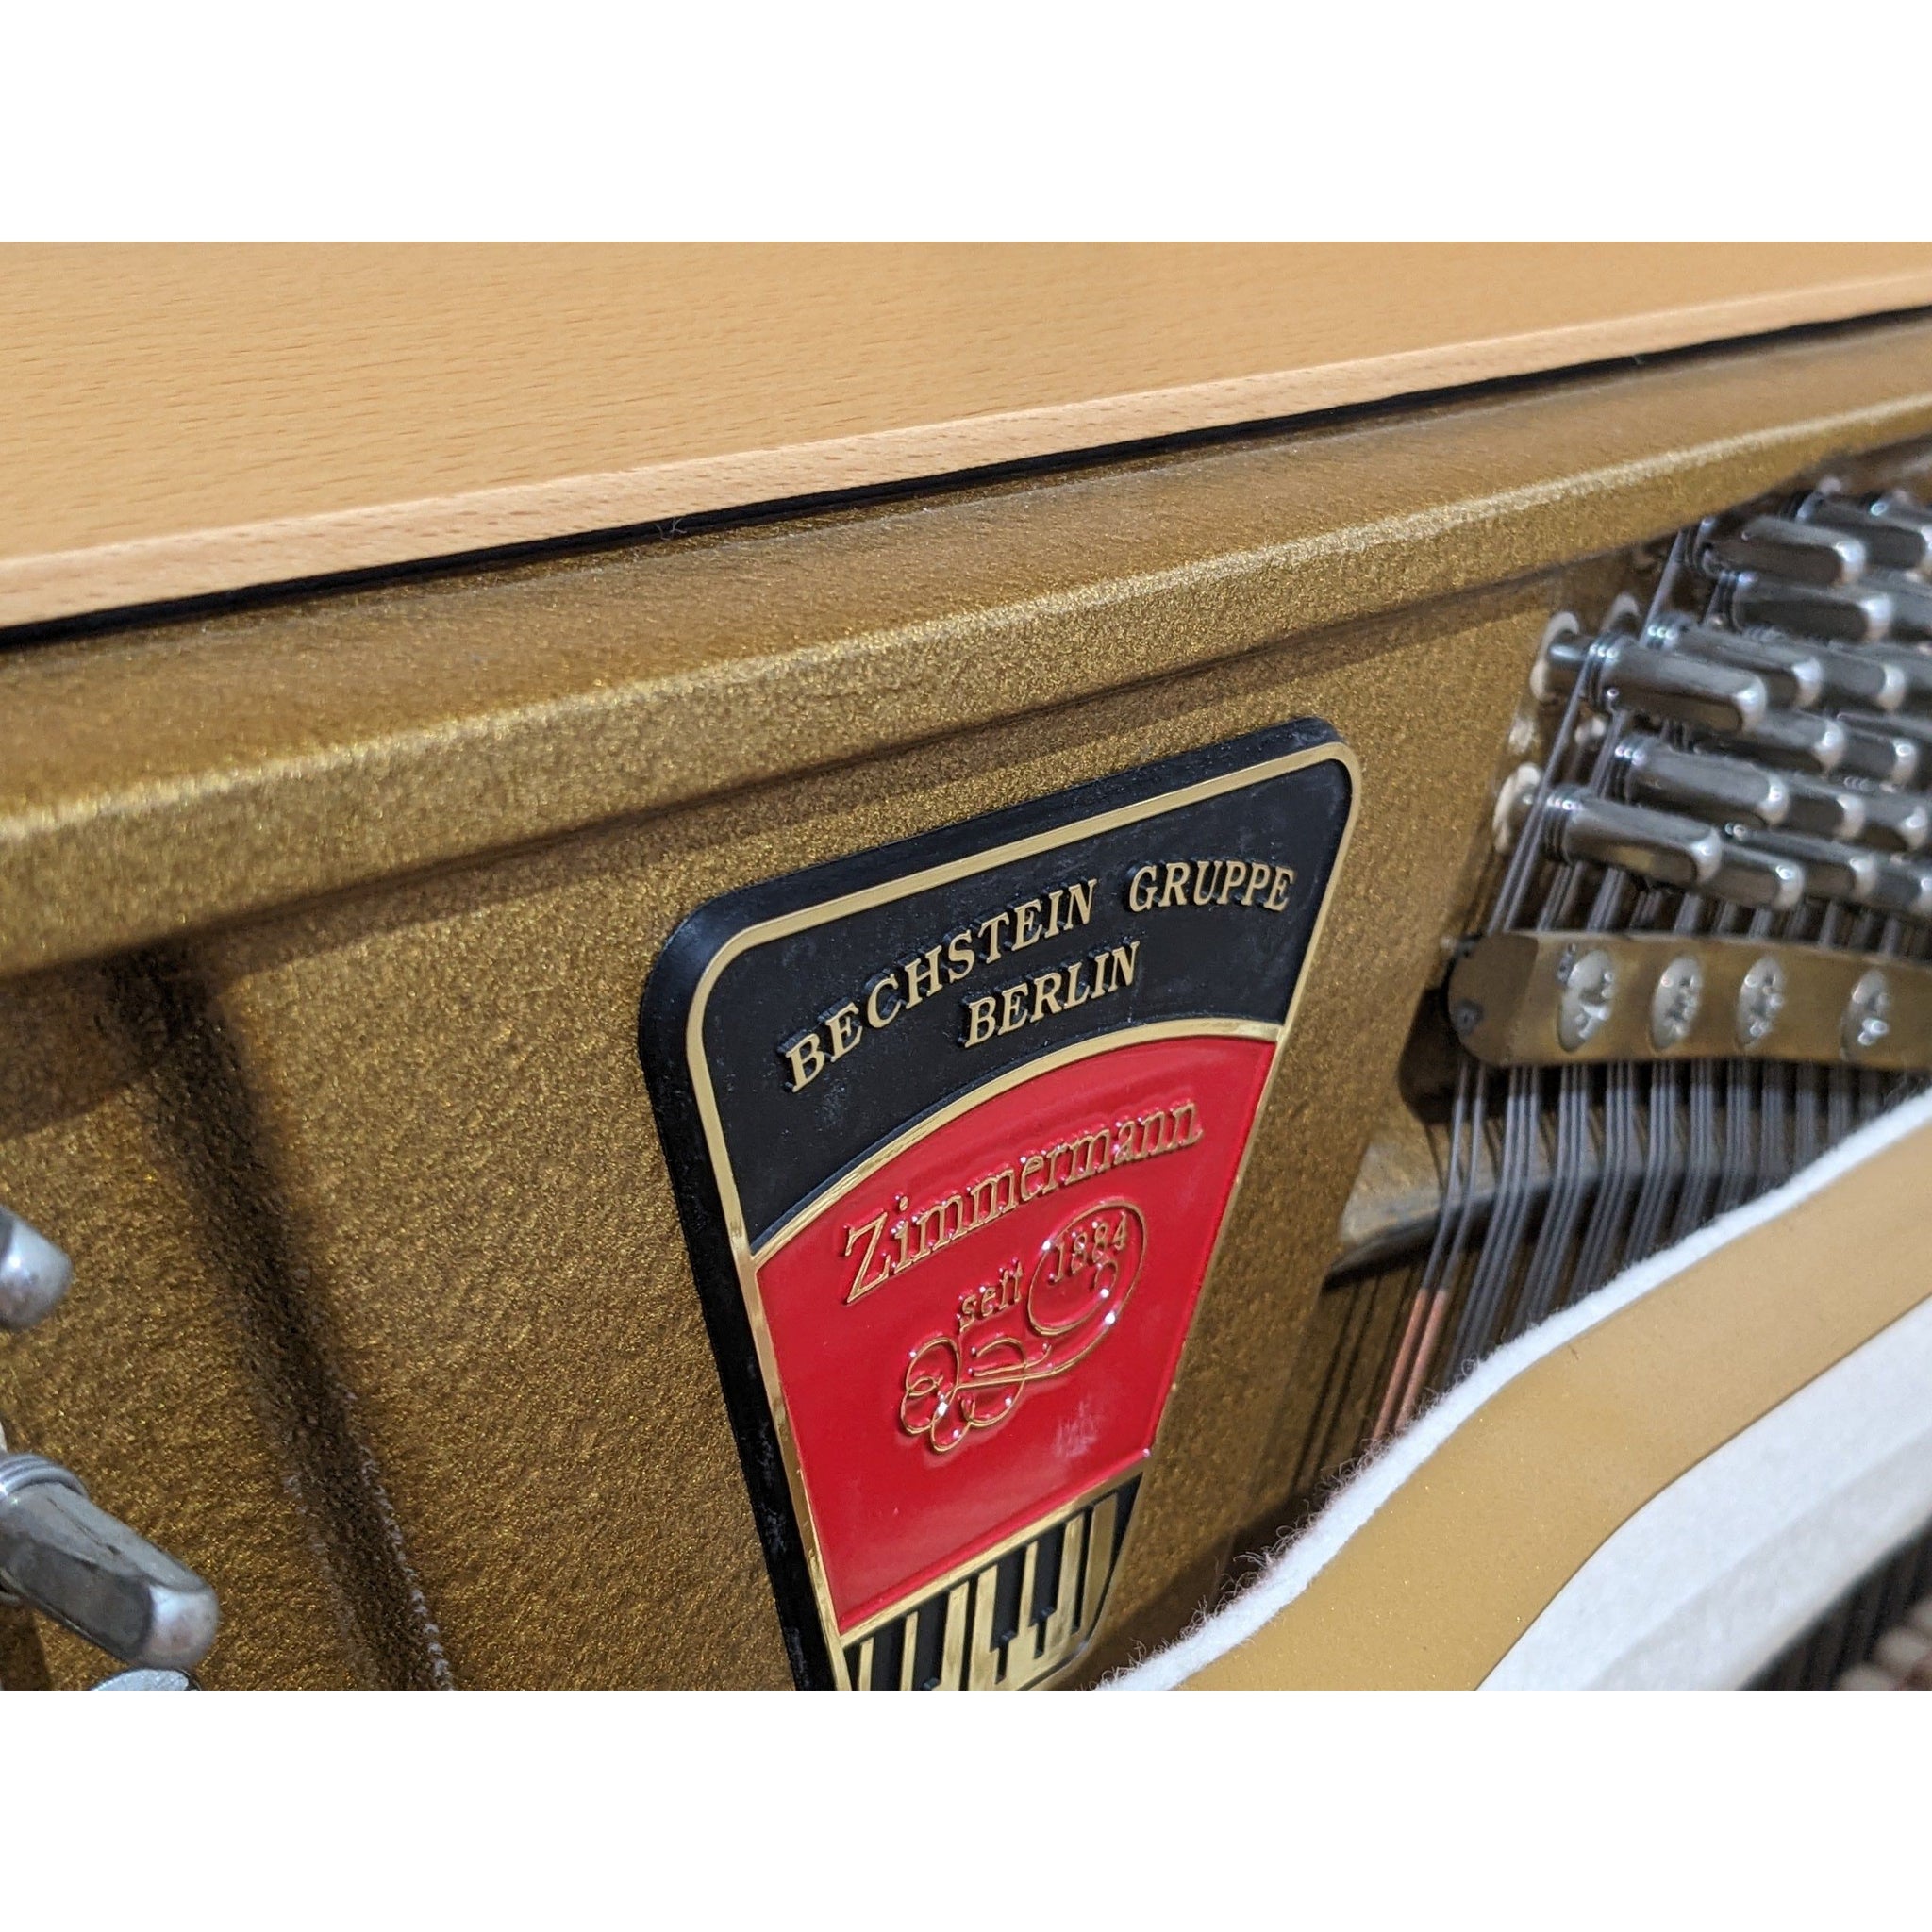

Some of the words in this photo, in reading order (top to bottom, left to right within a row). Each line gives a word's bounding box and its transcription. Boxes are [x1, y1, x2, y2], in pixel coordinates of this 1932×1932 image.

[784, 878, 1099, 1093] BECHSTEIN
[1127, 859, 1296, 913] GRUPPE
[963, 941, 1141, 1049] BERLIN
[842, 1101, 1205, 1306] Zimmermann
[958, 1259, 1024, 1331] seit
[1049, 1210, 1129, 1284] 1884
